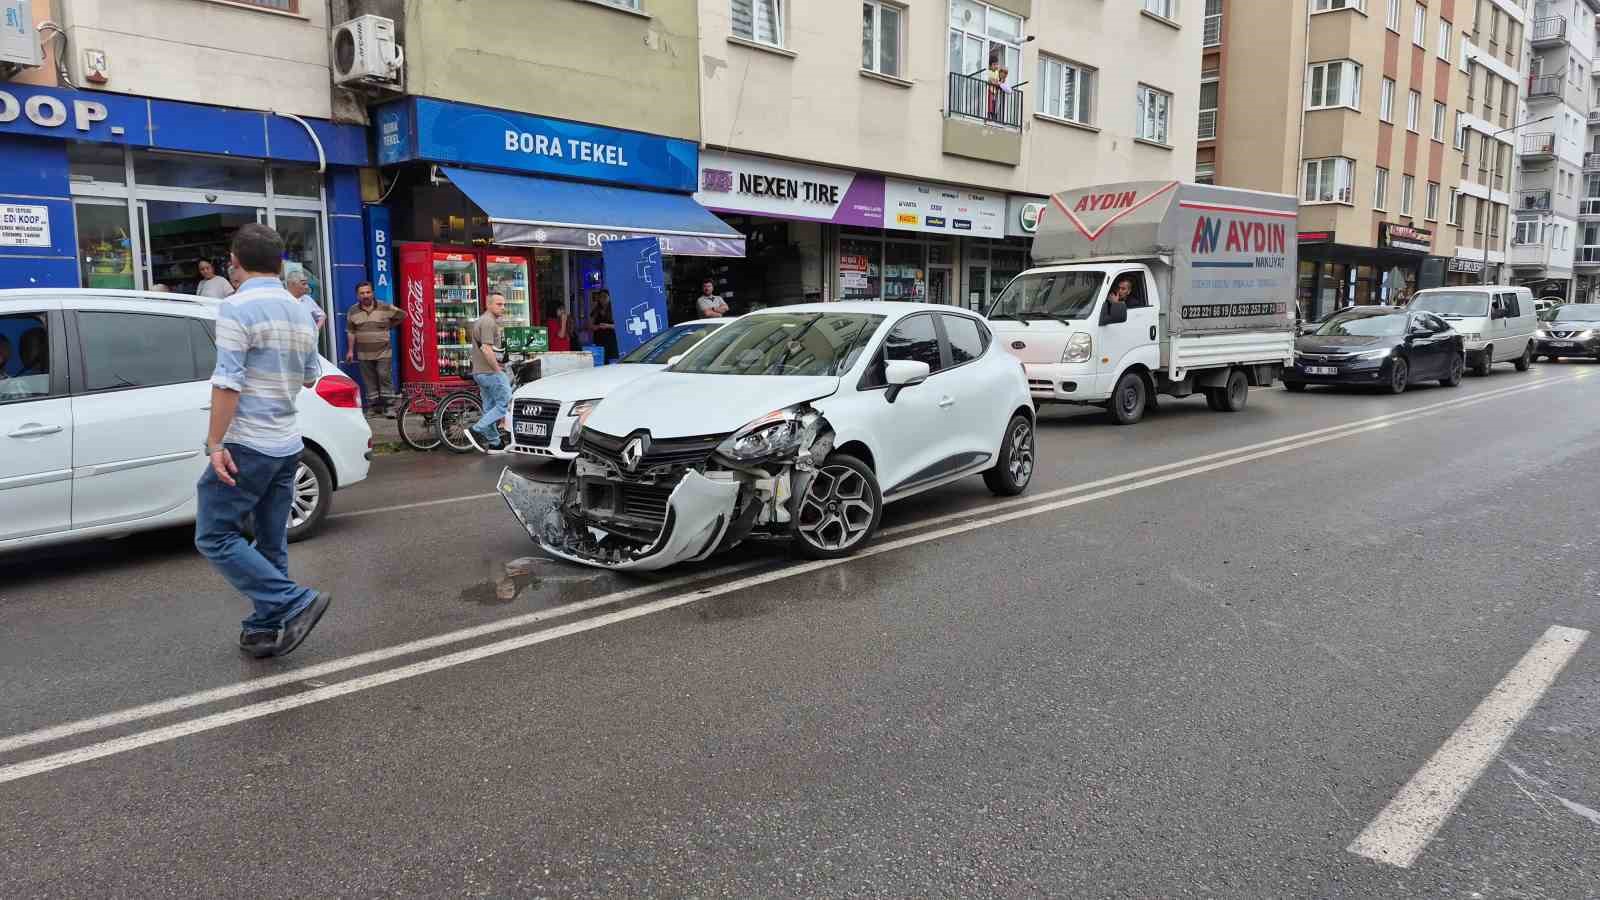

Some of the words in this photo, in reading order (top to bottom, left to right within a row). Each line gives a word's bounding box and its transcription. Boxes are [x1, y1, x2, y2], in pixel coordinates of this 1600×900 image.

[505, 130, 563, 158] BORA
[568, 139, 628, 166] TEKEL
[739, 173, 798, 199] NEXEN
[800, 181, 839, 204] TIRE
[1073, 190, 1137, 212] AYDIN
[1226, 220, 1285, 254] AYDIN
[375, 229, 388, 286] BORA
